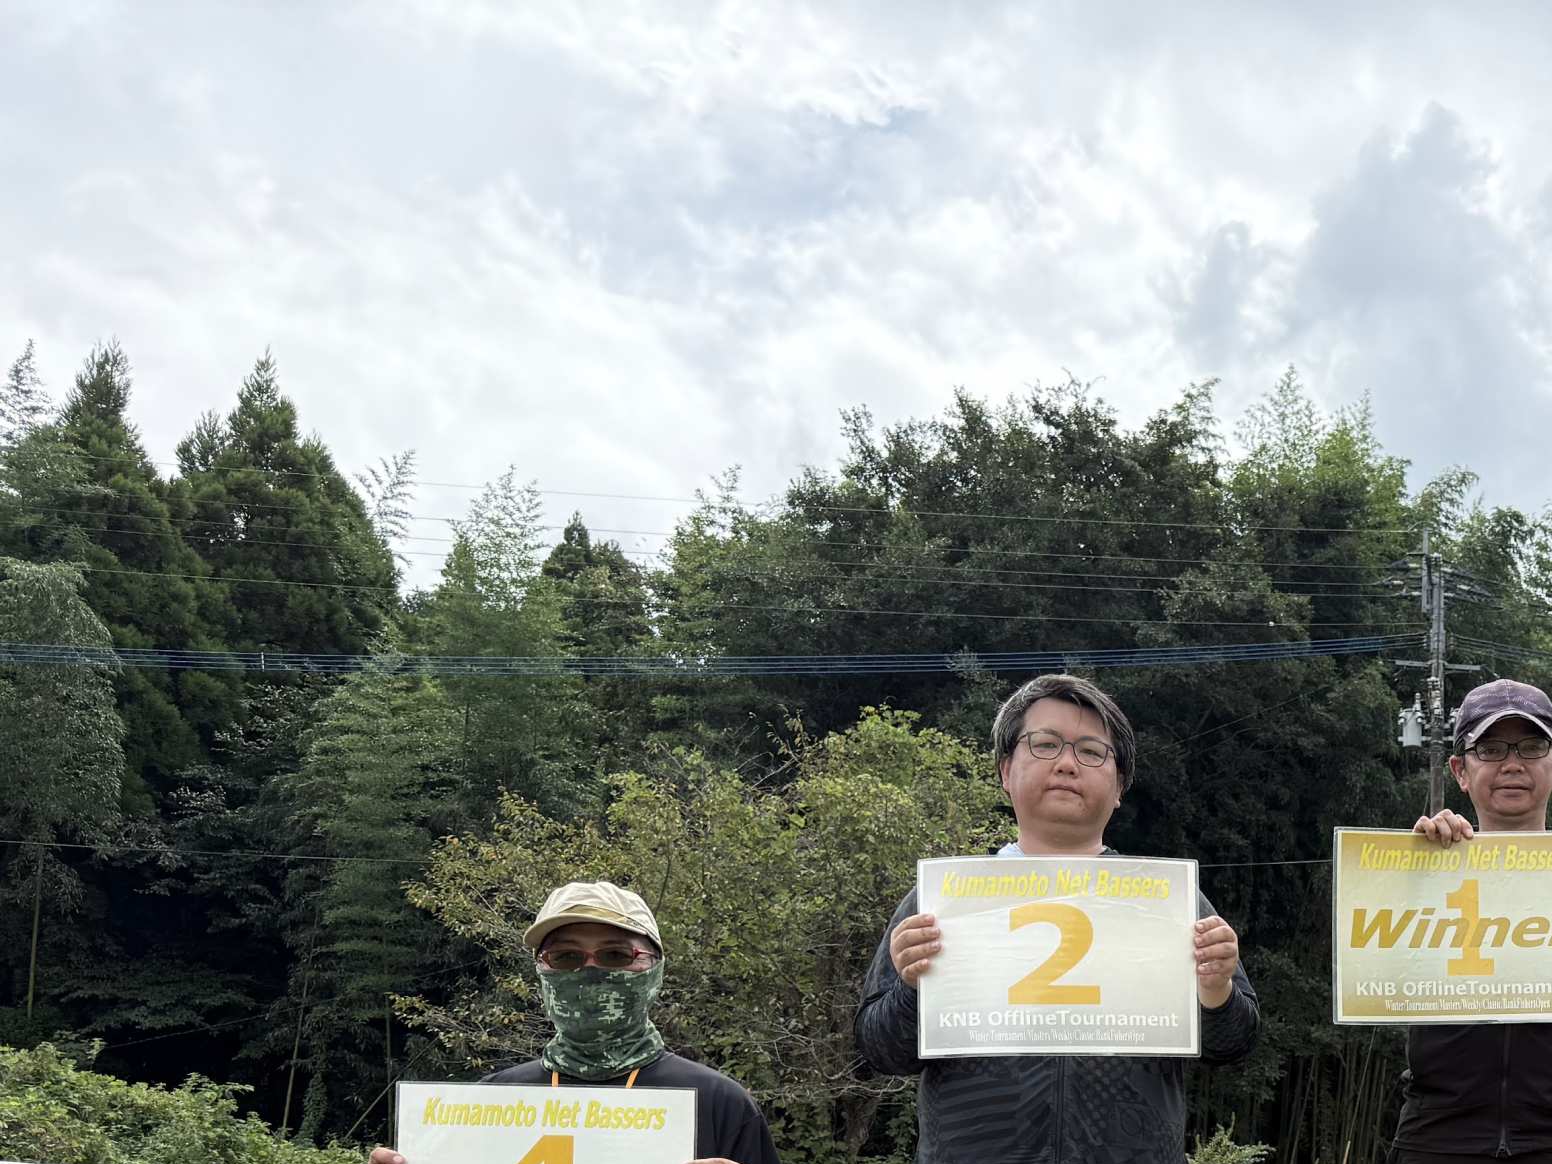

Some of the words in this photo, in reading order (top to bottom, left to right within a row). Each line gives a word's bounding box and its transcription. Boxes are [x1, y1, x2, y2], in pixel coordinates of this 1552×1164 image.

[1359, 843, 1460, 872] Kumamoto
[1465, 844, 1501, 872] Net
[940, 870, 1048, 898] Kumamoto
[1053, 869, 1092, 897] Net
[1095, 870, 1171, 900] Bassers
[1445, 879, 1495, 976] 1
[1008, 903, 1101, 1005] 2
[1356, 981, 1396, 996] KNB
[939, 1011, 981, 1028] KNB
[988, 1010, 1178, 1027] OfflineTournament
[421, 1097, 536, 1128] Kumamoto
[541, 1098, 580, 1128] Net
[583, 1100, 668, 1130] Bassers
